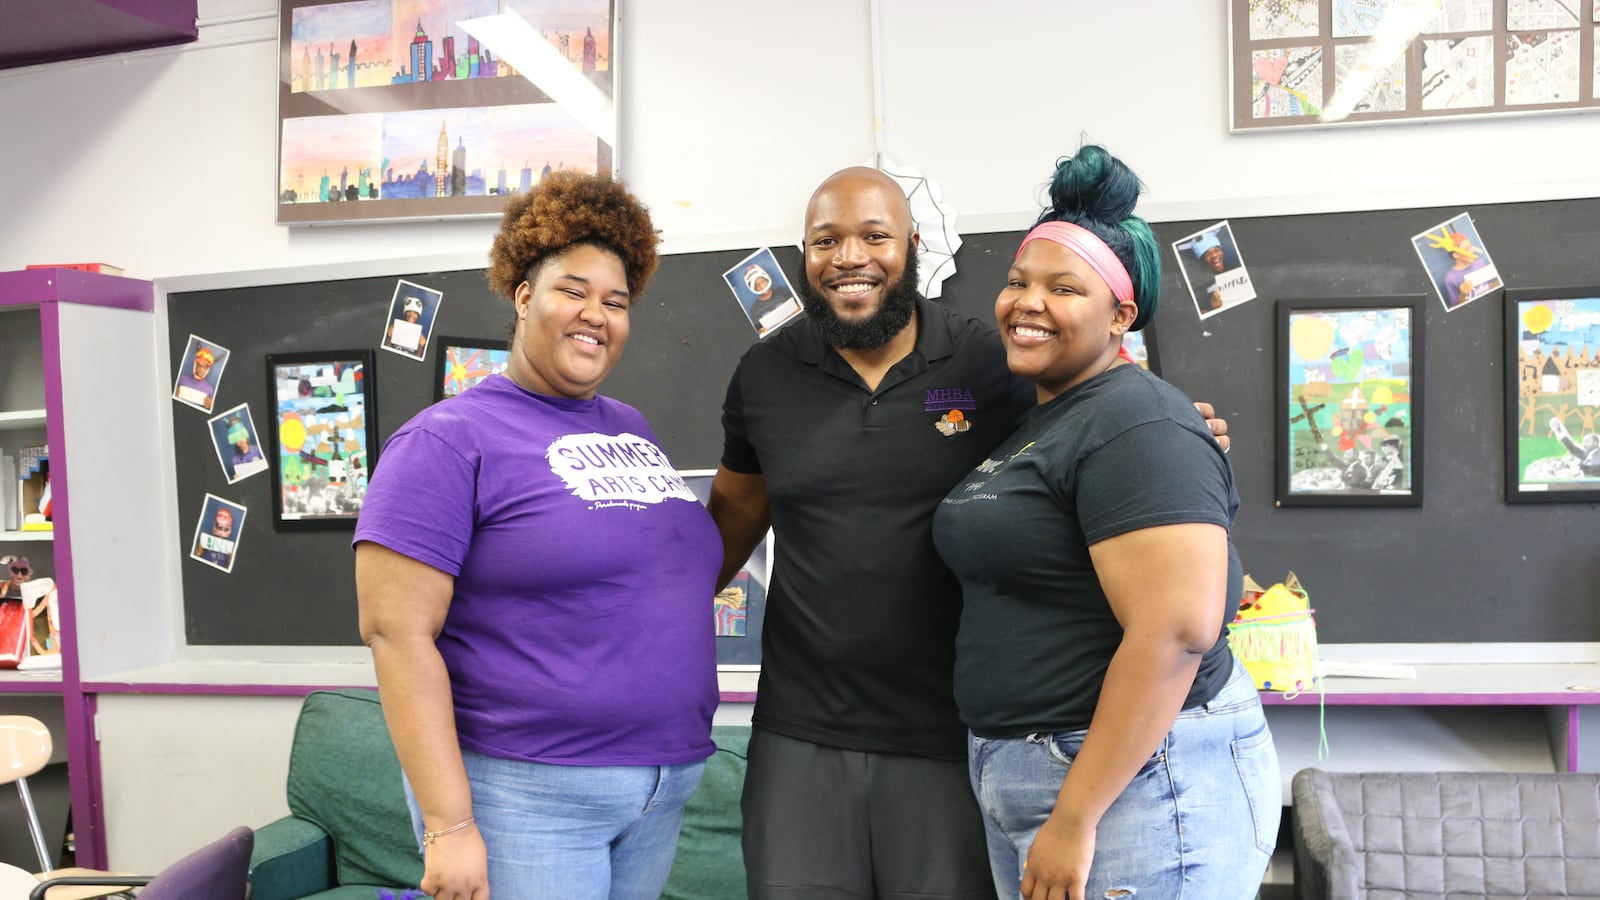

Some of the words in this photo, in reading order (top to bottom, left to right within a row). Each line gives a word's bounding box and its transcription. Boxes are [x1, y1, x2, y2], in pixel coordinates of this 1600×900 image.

[926, 388, 973, 401] MHBA
[558, 442, 671, 471] SUMMER
[588, 475, 647, 496] ARTS
